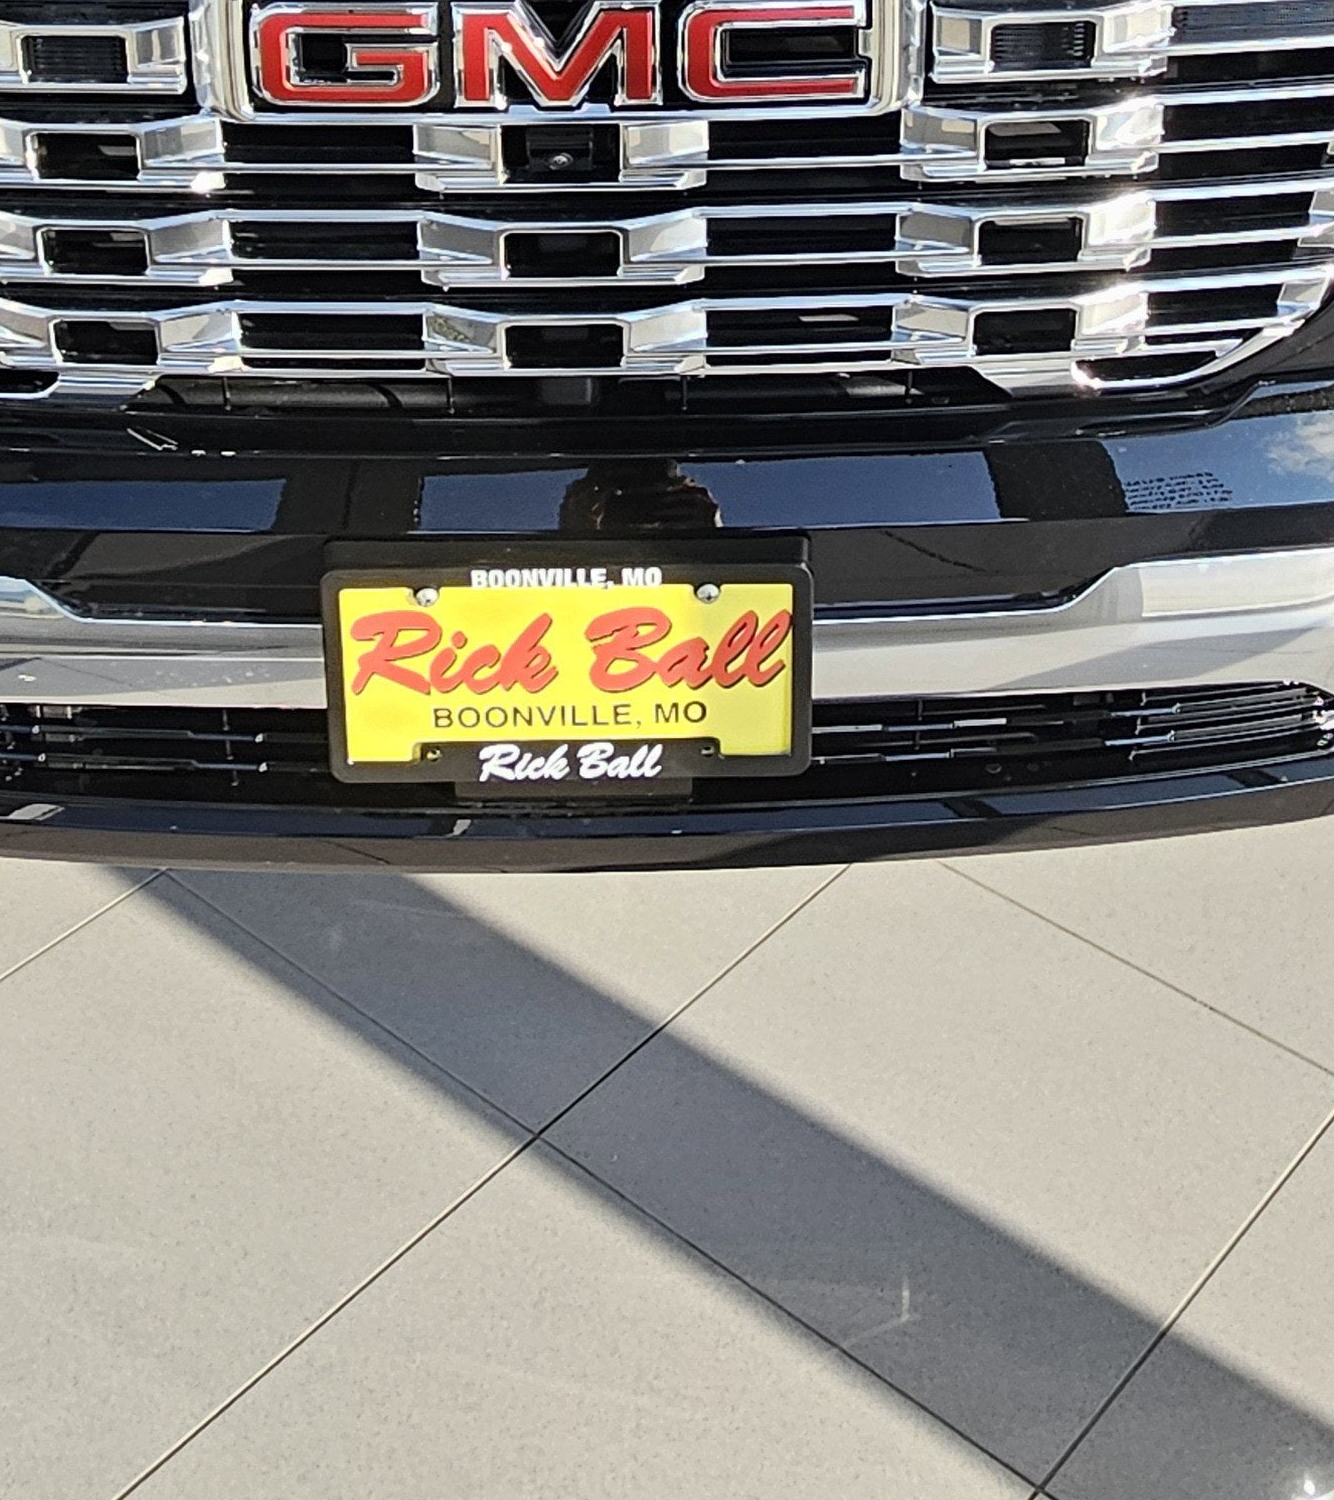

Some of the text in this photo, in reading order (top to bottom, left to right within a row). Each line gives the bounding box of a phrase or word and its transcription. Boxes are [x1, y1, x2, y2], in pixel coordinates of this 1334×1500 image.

[470, 567, 663, 589] BOONVILLE, MO
[350, 606, 793, 695] Rick Ball
[433, 700, 707, 729] BOONVILLE, MO
[478, 741, 663, 782] Rick Ball
